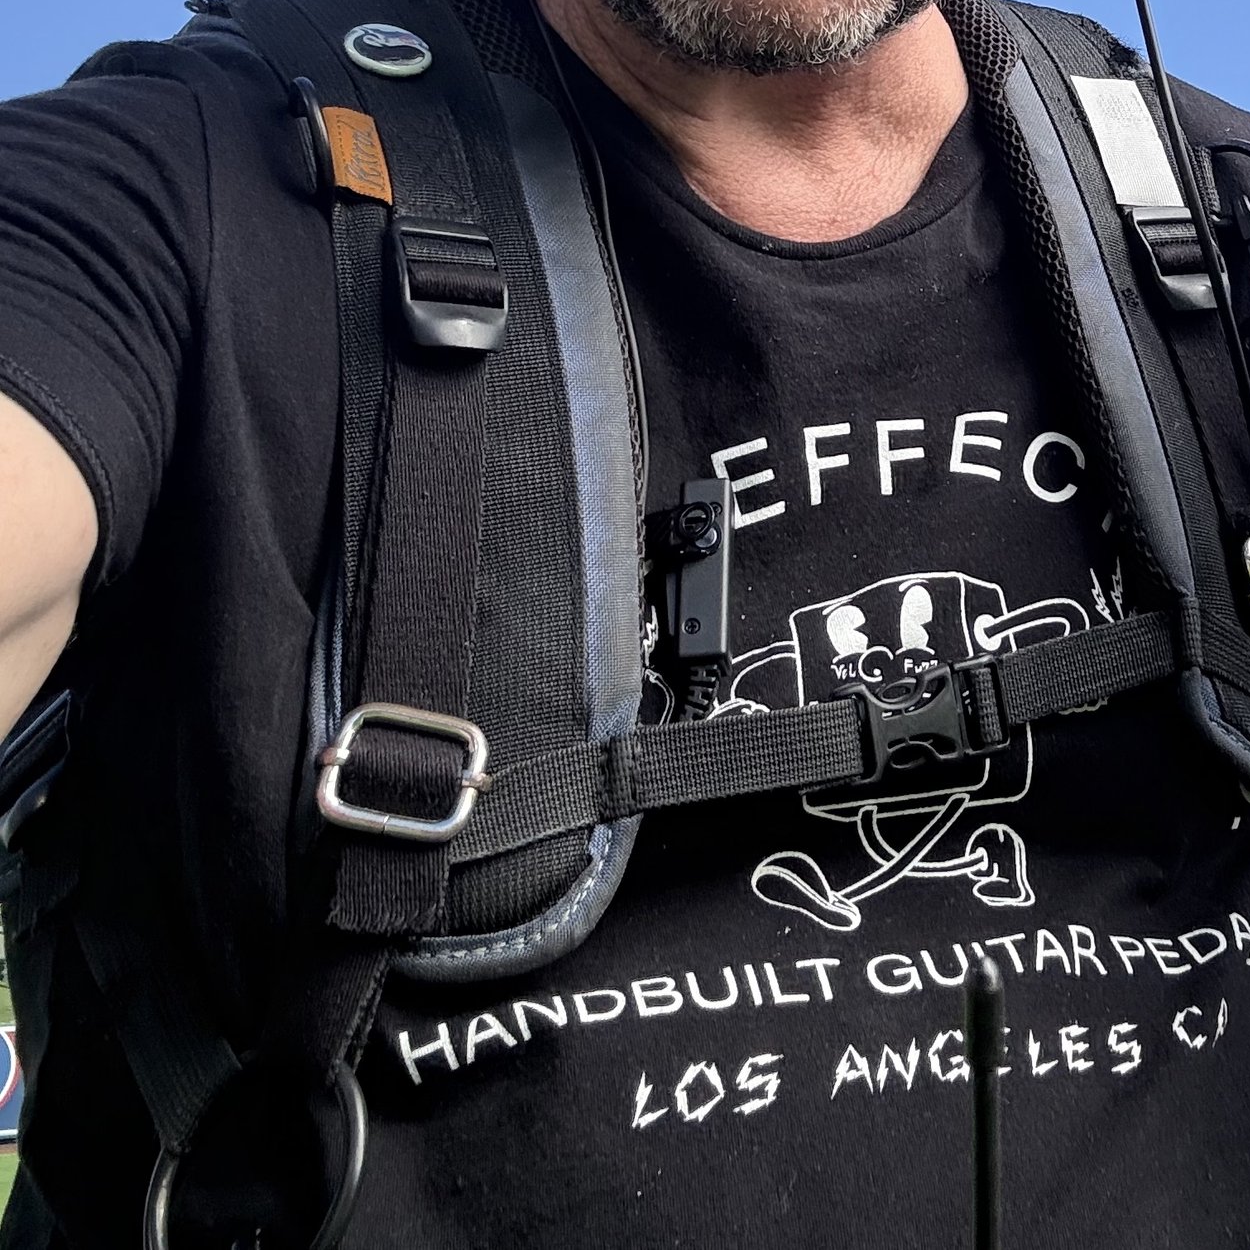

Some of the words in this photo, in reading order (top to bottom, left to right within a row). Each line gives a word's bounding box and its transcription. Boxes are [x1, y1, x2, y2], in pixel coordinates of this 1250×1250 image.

[710, 410, 1112, 532] EFFEC
[398, 957, 841, 1084] HANDBUILT
[631, 1052, 785, 1129] LOS
